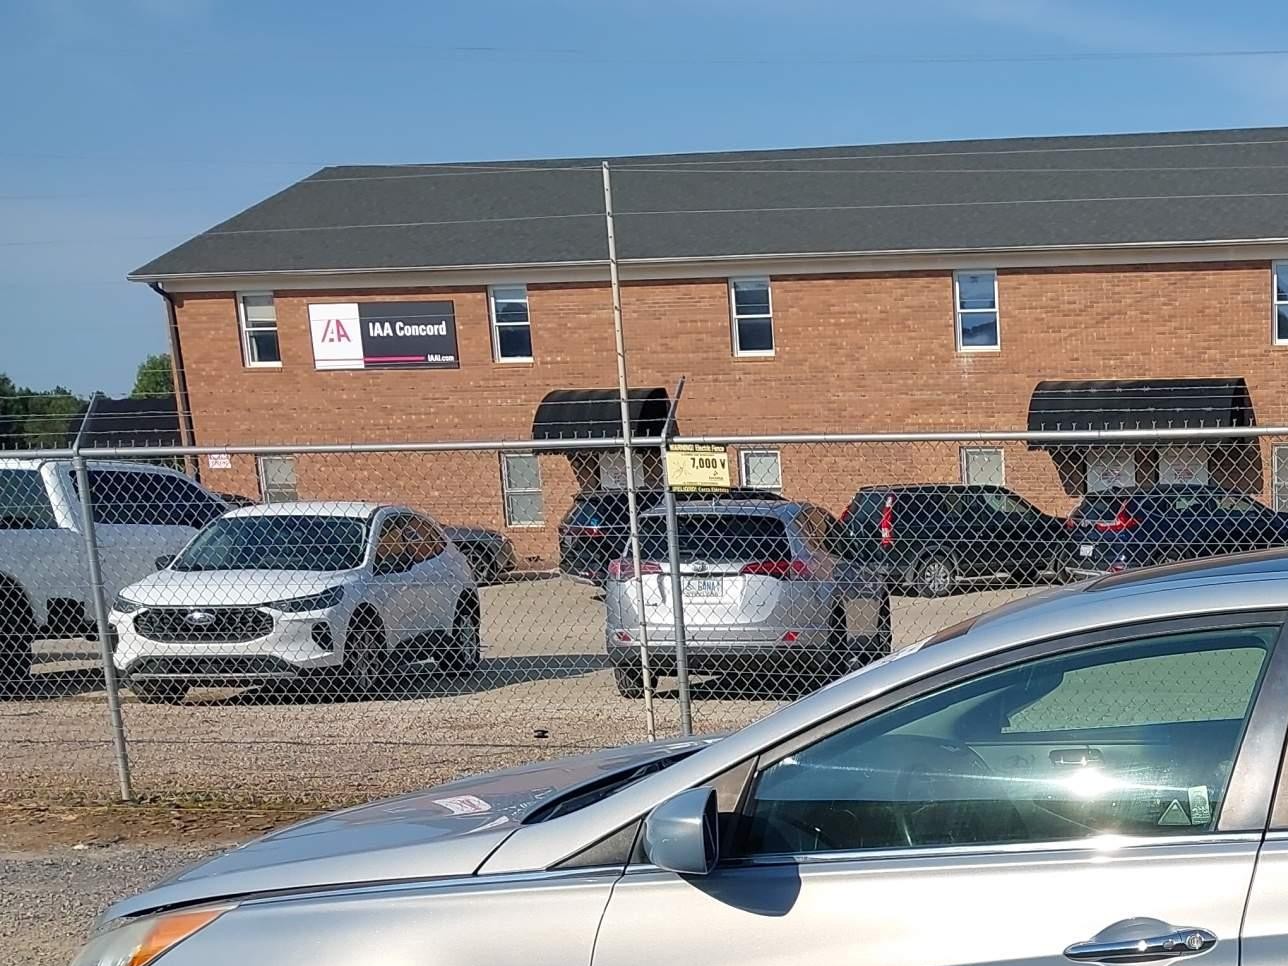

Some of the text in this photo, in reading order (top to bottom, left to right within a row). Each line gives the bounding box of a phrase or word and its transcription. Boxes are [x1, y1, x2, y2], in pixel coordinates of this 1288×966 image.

[368, 321, 447, 337] IAA Concord
[690, 457, 726, 470] 7,000 V
